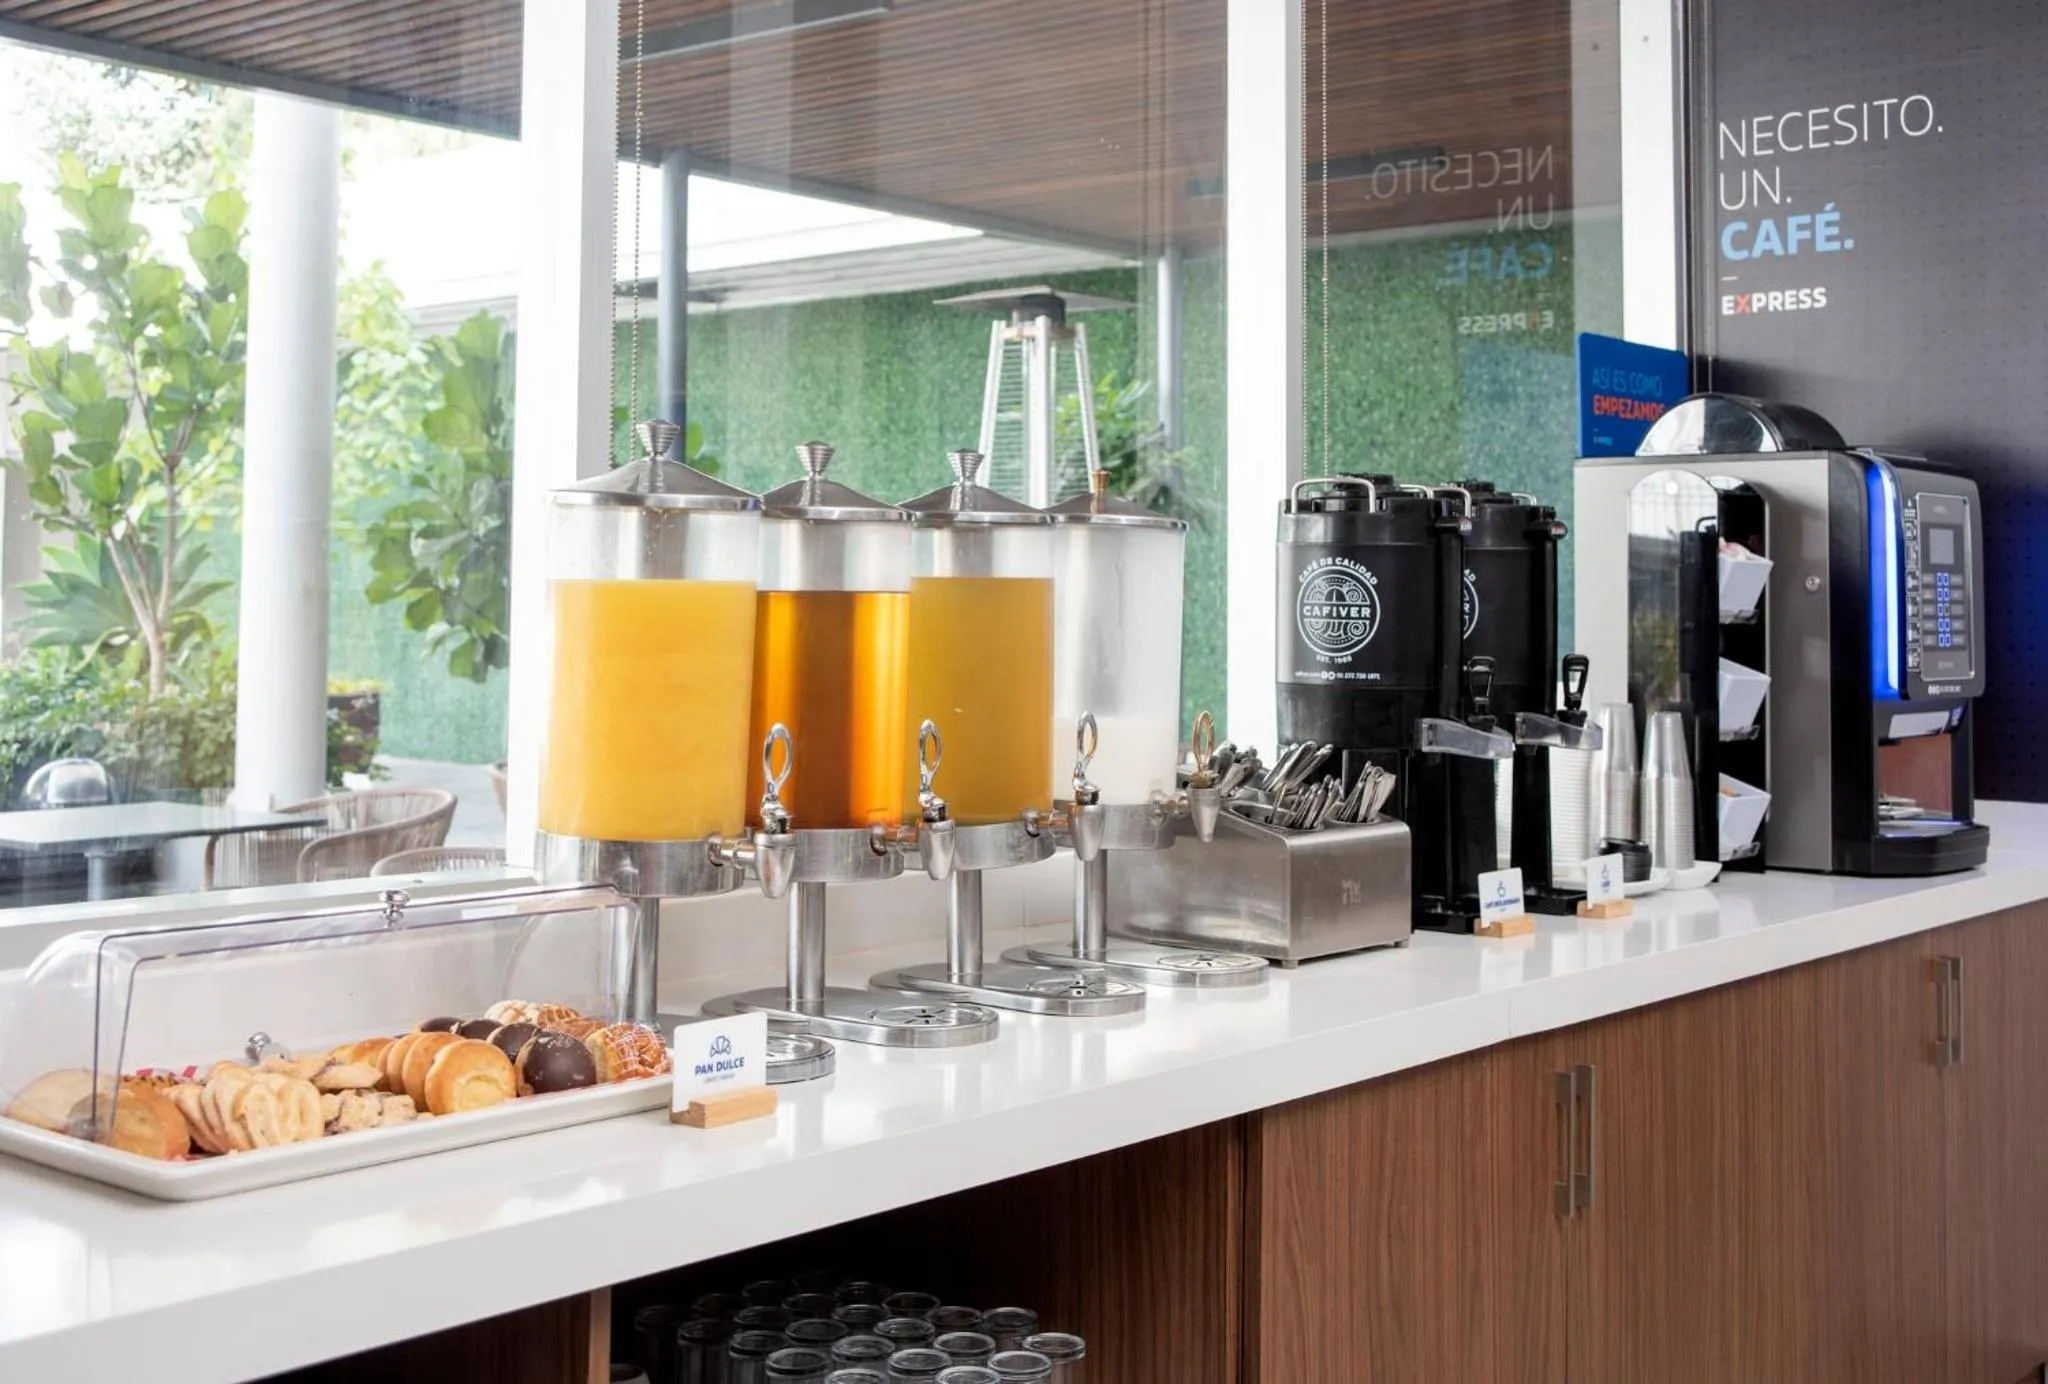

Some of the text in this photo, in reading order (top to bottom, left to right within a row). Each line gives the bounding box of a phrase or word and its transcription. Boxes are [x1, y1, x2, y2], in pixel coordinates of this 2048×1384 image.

[1719, 94, 1944, 160] NECESITO.
[1719, 166, 1792, 210] UN.
[1720, 202, 1855, 260] CAFÉ.
[1721, 287, 1828, 316] EXPRESS
[1613, 369, 1627, 392] ES
[1629, 372, 1663, 398] COMO
[1335, 556, 1378, 586] CALIDAD
[1302, 605, 1372, 618] CAFIVER
[694, 1057, 745, 1076] PAN DULCE
